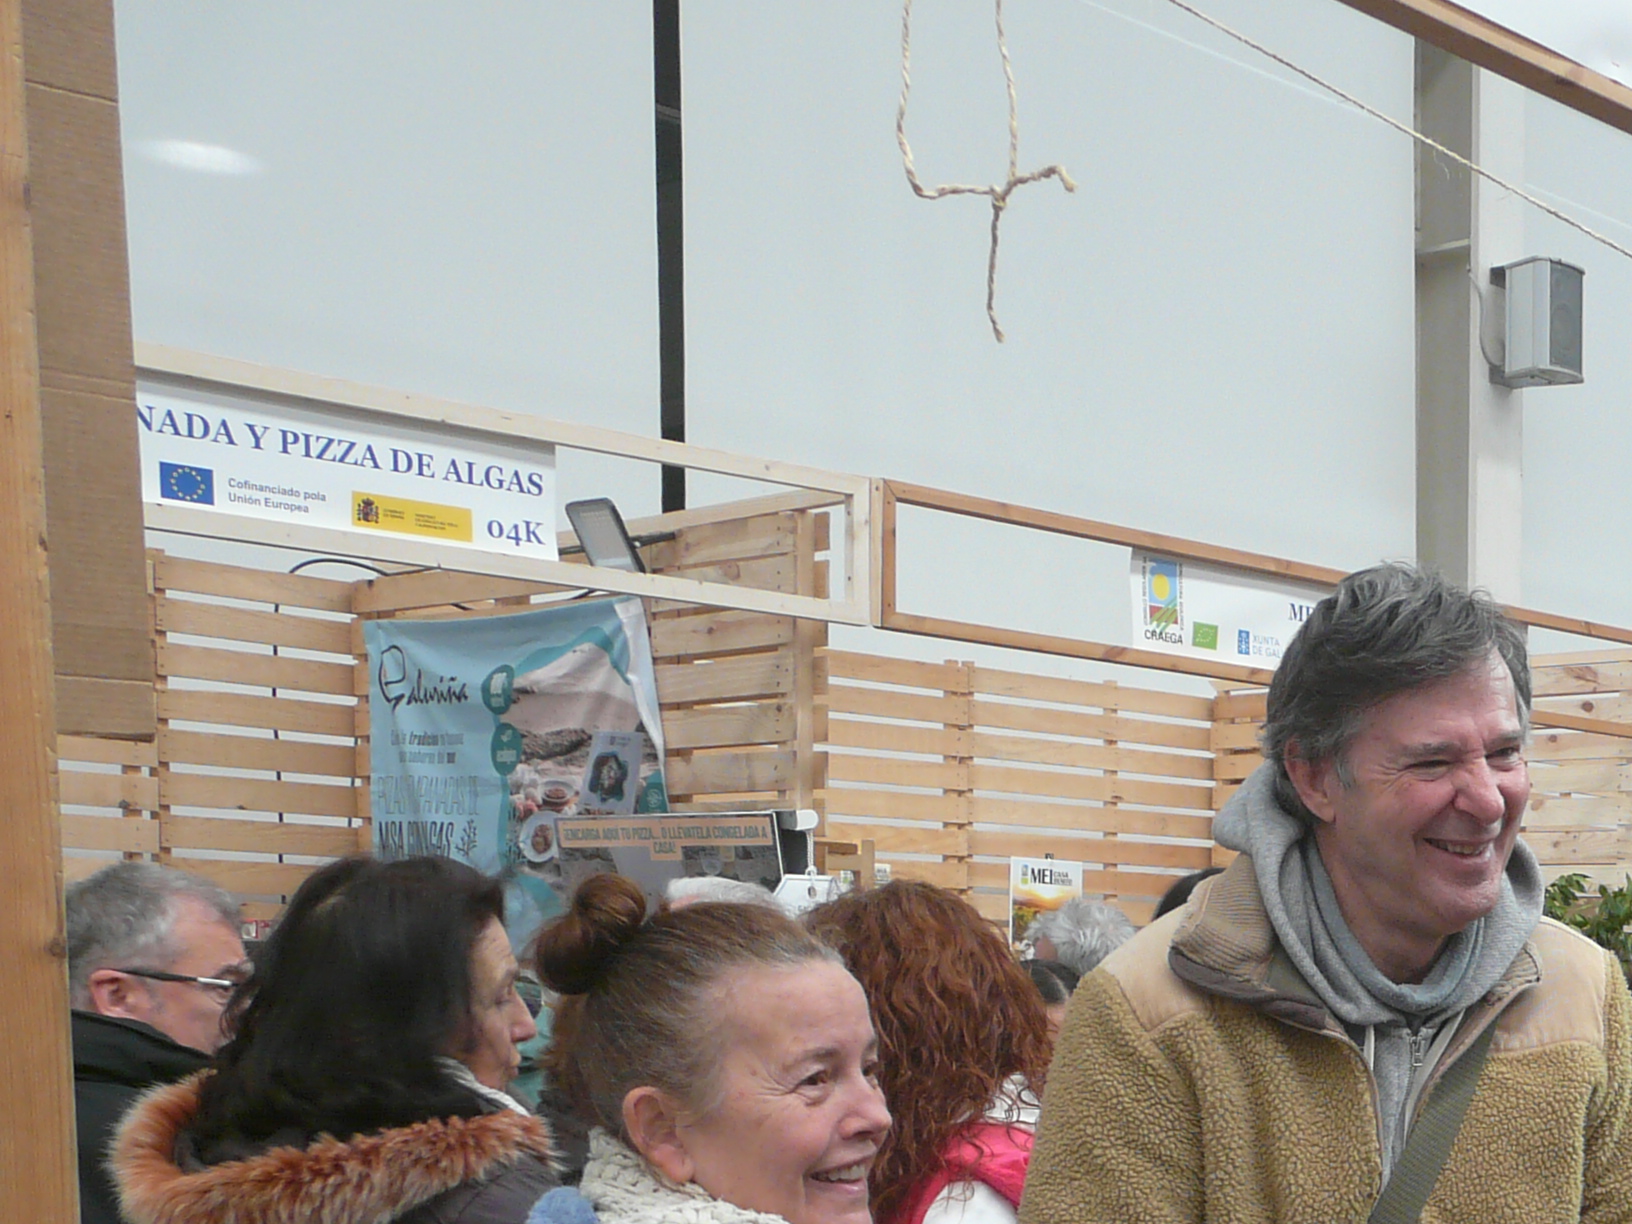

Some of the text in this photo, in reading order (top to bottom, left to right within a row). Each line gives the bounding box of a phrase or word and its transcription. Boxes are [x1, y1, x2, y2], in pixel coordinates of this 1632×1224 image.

[244, 422, 270, 450] Y
[278, 428, 382, 470] PIZZA
[389, 447, 435, 478] DE
[443, 458, 544, 496] ALGAS
[228, 478, 326, 503] Cofinanciado pola
[228, 492, 309, 514] Unión Europea
[487, 519, 546, 547] 04K
[1144, 629, 1183, 645] CRAEGA
[1252, 634, 1280, 646] XUNTA
